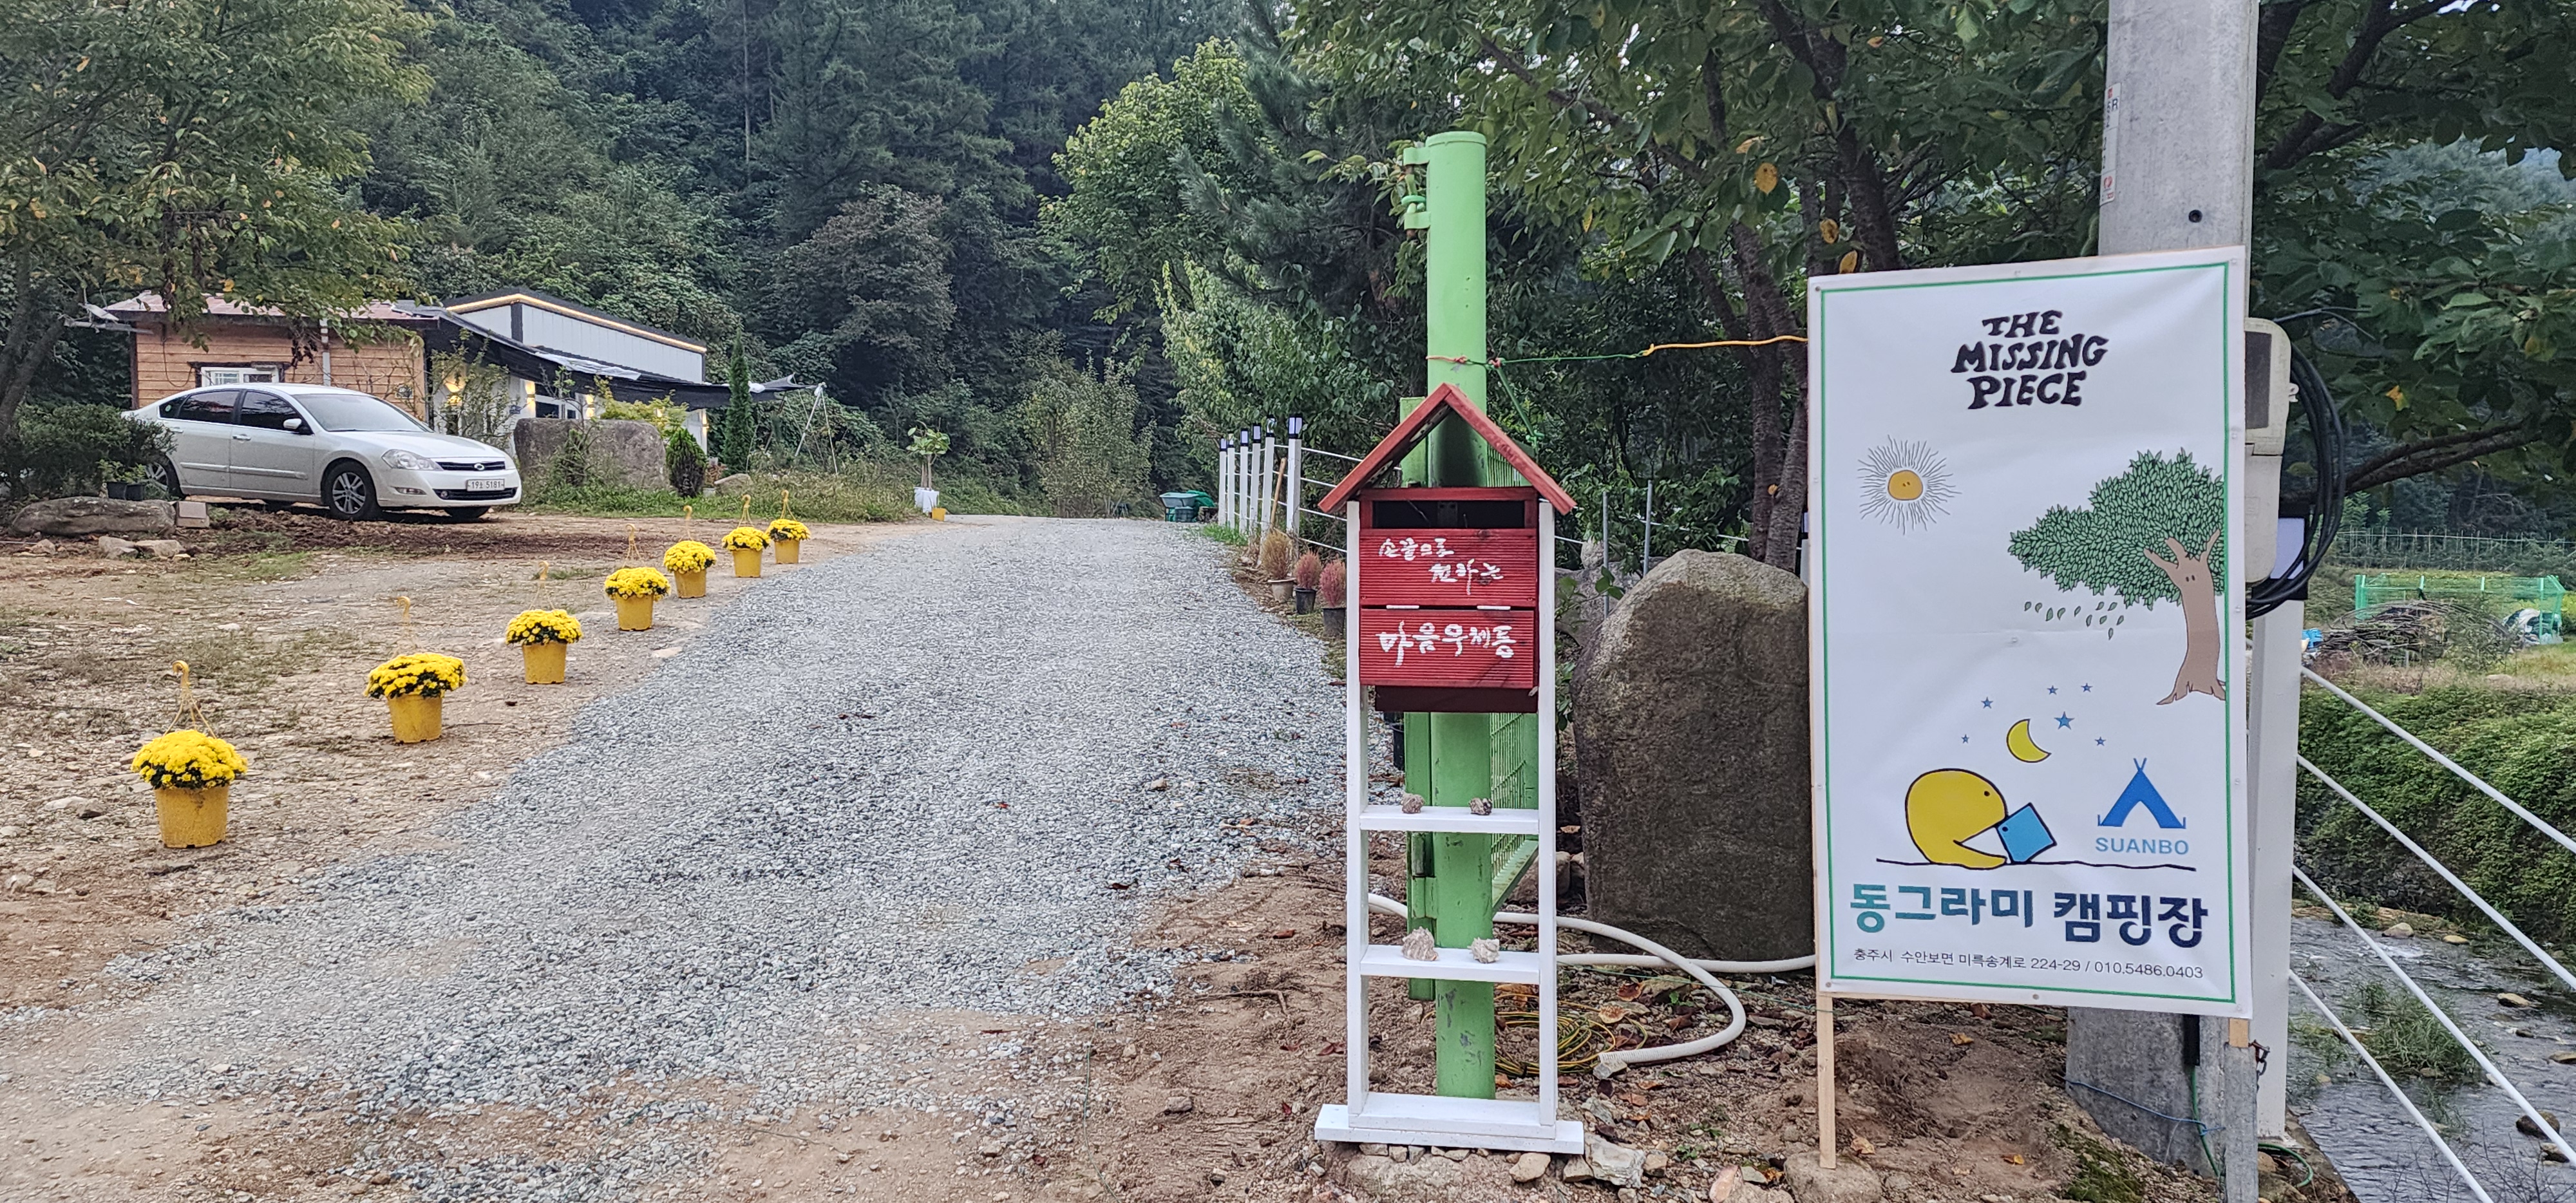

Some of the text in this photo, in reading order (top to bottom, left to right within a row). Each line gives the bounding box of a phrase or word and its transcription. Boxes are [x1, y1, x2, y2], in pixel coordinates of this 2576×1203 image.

[1982, 310, 2063, 338] THE
[1951, 334, 2108, 373] MISSING
[1966, 370, 2087, 410] PIECE
[2096, 837, 2189, 855] SUANBO
[1850, 884, 2209, 949] 동그라미 캠핑장
[1853, 948, 1893, 962] 충주시
[1900, 951, 1954, 965] 수안보면
[1959, 954, 2026, 969] 미륵송계로
[2031, 958, 2081, 971] 224-29
[2094, 961, 2203, 978] 010.5486.0403
